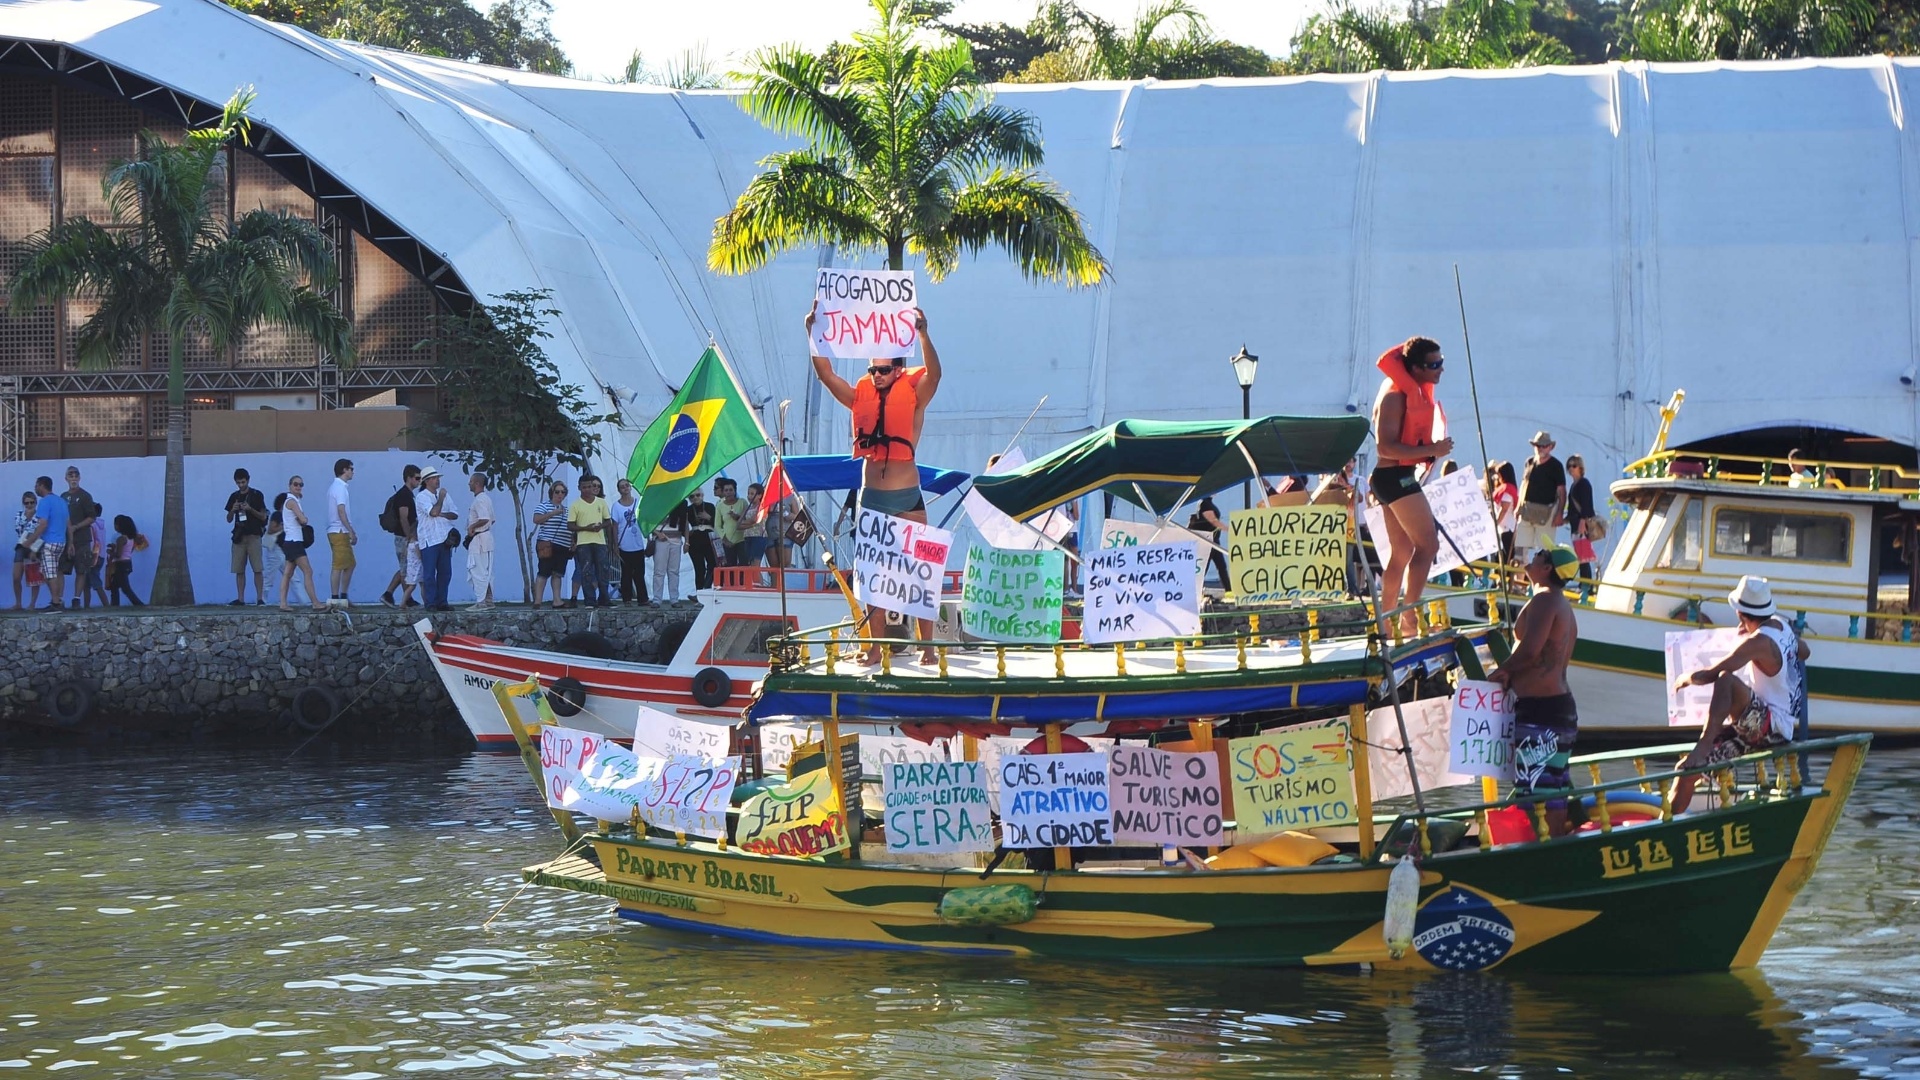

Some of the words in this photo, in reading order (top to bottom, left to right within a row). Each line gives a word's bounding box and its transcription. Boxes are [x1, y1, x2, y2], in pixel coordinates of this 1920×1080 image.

[818, 272, 914, 304] AFOGADOS
[822, 309, 916, 347] JAMAIS
[858, 511, 897, 547] CAIS
[915, 543, 947, 560] MAIOR
[1230, 510, 1347, 537] VALORIZAR
[855, 543, 933, 582] ATRATIVO
[968, 547, 984, 562] NA
[989, 549, 1045, 567] CIDADE
[1091, 551, 1126, 571] MAIS
[1137, 548, 1194, 565] RESPEITO
[1230, 545, 1244, 562] A
[1249, 538, 1343, 560] BALEEIRA
[868, 573, 936, 609] CIDADE
[968, 565, 982, 582] DA
[988, 571, 1039, 590] FLIP
[1044, 577, 1062, 591] AS
[1089, 575, 1111, 591] SOU
[1241, 565, 1346, 596] CAIÇARA
[963, 584, 1025, 611] ESCOLAS
[1032, 592, 1062, 611] NÃO
[1095, 597, 1103, 608] E
[1115, 589, 1153, 605] VIVO
[1164, 590, 1183, 603] DO
[961, 608, 981, 626] TEM
[981, 610, 1060, 639] PROFESSOR
[1467, 718, 1491, 737] DA
[893, 762, 978, 789] PARATY
[1064, 767, 1105, 786] MAIOR
[1111, 750, 1172, 780] SALVE
[1185, 757, 1206, 780] O
[886, 791, 921, 807] CIDADE
[921, 793, 933, 803] DA
[1011, 787, 1108, 815] ATRATIVO
[1122, 782, 1220, 808] TURISMO
[1244, 777, 1336, 804] TURISMO
[1113, 810, 1223, 838] NAUTICO
[1262, 801, 1348, 827] NÁUTICO
[1007, 823, 1031, 844] DA
[1036, 819, 1112, 846] CIDADE
[1601, 839, 1673, 879] LULA
[1685, 822, 1754, 864] LELE
[616, 847, 698, 883] PARATY
[703, 860, 783, 897] BRASIL
[1414, 925, 1455, 947] ORDEM
